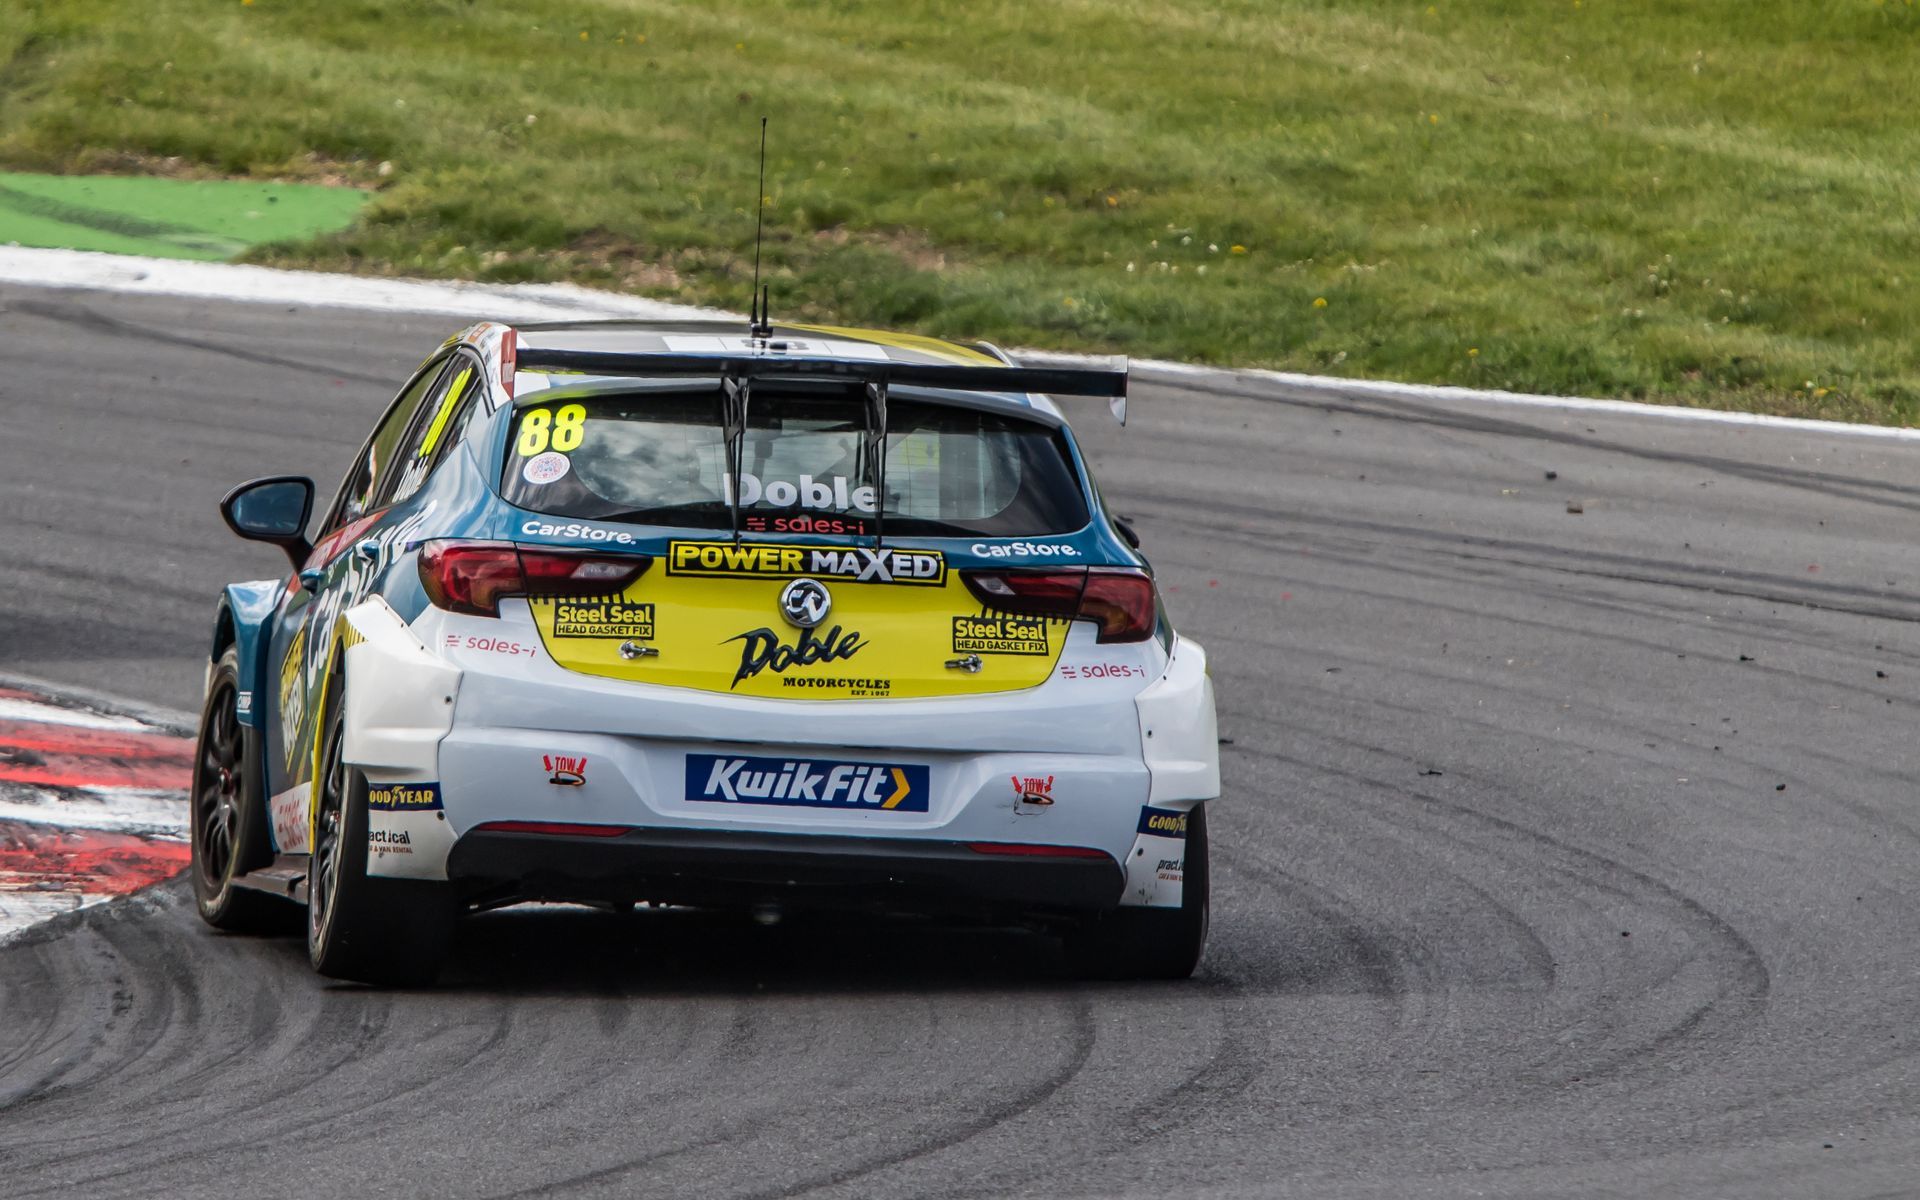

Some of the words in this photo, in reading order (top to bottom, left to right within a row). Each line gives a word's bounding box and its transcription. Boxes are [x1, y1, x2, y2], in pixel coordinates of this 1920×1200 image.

[518, 404, 587, 457] 88
[723, 472, 877, 513] Doble
[521, 521, 637, 545] CarStore.
[775, 516, 865, 535] sales-i
[971, 542, 1082, 558] CarStore.
[676, 545, 804, 573] POWER
[811, 548, 939, 582] MAXED
[557, 605, 607, 623] Steel
[611, 605, 652, 624] Seal
[557, 624, 587, 634] HEAD
[588, 625, 630, 635] GASKET
[632, 626, 650, 635] FIX
[955, 619, 1003, 638] Steel
[1005, 622, 1045, 640] Seal
[466, 635, 537, 658] sales-i
[957, 639, 985, 649] HEAD
[986, 640, 1026, 651] GASKET
[1028, 641, 1045, 651] FIX
[718, 625, 869, 690] Doble
[1081, 662, 1145, 679] sales-i
[783, 677, 891, 689] MOTORCYCLES
[555, 757, 577, 772] TOW
[703, 758, 888, 804] KwikFit
[1023, 777, 1044, 793] TOW
[368, 787, 434, 806] OODYEAR
[368, 829, 411, 845] actical
